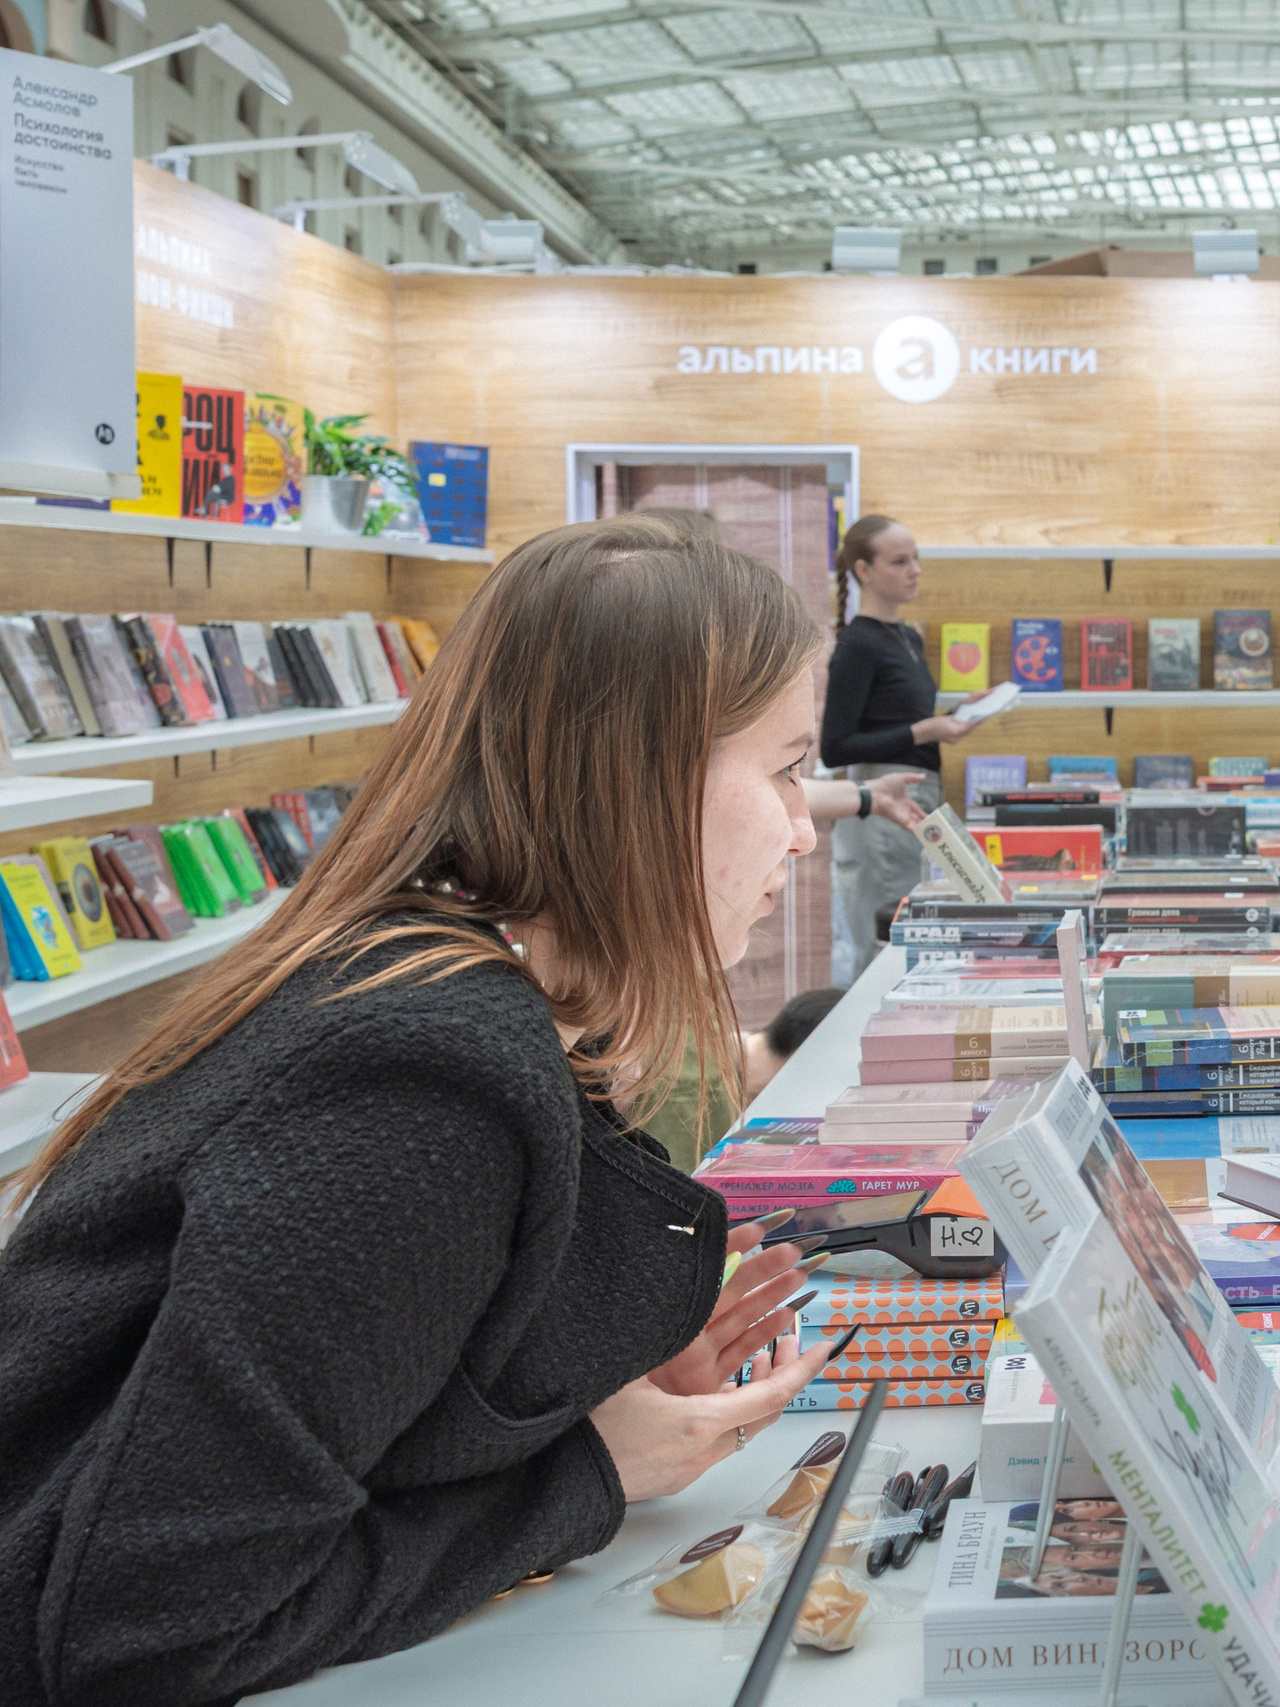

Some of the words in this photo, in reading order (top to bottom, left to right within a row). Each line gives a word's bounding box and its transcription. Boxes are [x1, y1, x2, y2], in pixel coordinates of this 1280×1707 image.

[13, 75, 98, 107] Александр
[13, 91, 81, 117] Асмолов
[14, 112, 104, 142] Психология
[14, 132, 112, 160] достоинства
[676, 345, 864, 374] альпина
[969, 347, 1098, 374] книги
[904, 926, 960, 938] ГРАД
[968, 1036, 979, 1049] 6
[1238, 1044, 1249, 1054] 6
[1207, 1072, 1218, 1081] 6
[1208, 1099, 1219, 1108] 6
[720, 1182, 774, 1191] ТРЕНАЖЕР
[777, 1182, 815, 1191] МОЗГА
[862, 1181, 892, 1190] ГАРЕТ
[895, 1180, 920, 1190] МУР
[991, 1159, 1048, 1224] ДОМ
[1007, 1456, 1040, 1468] Дэвид
[957, 1511, 988, 1548] БРАУН
[1109, 1449, 1208, 1594] МЕНТАЛИТЕТ
[948, 1552, 979, 1588] ТИНА
[943, 1646, 1014, 1674] ДОМ
